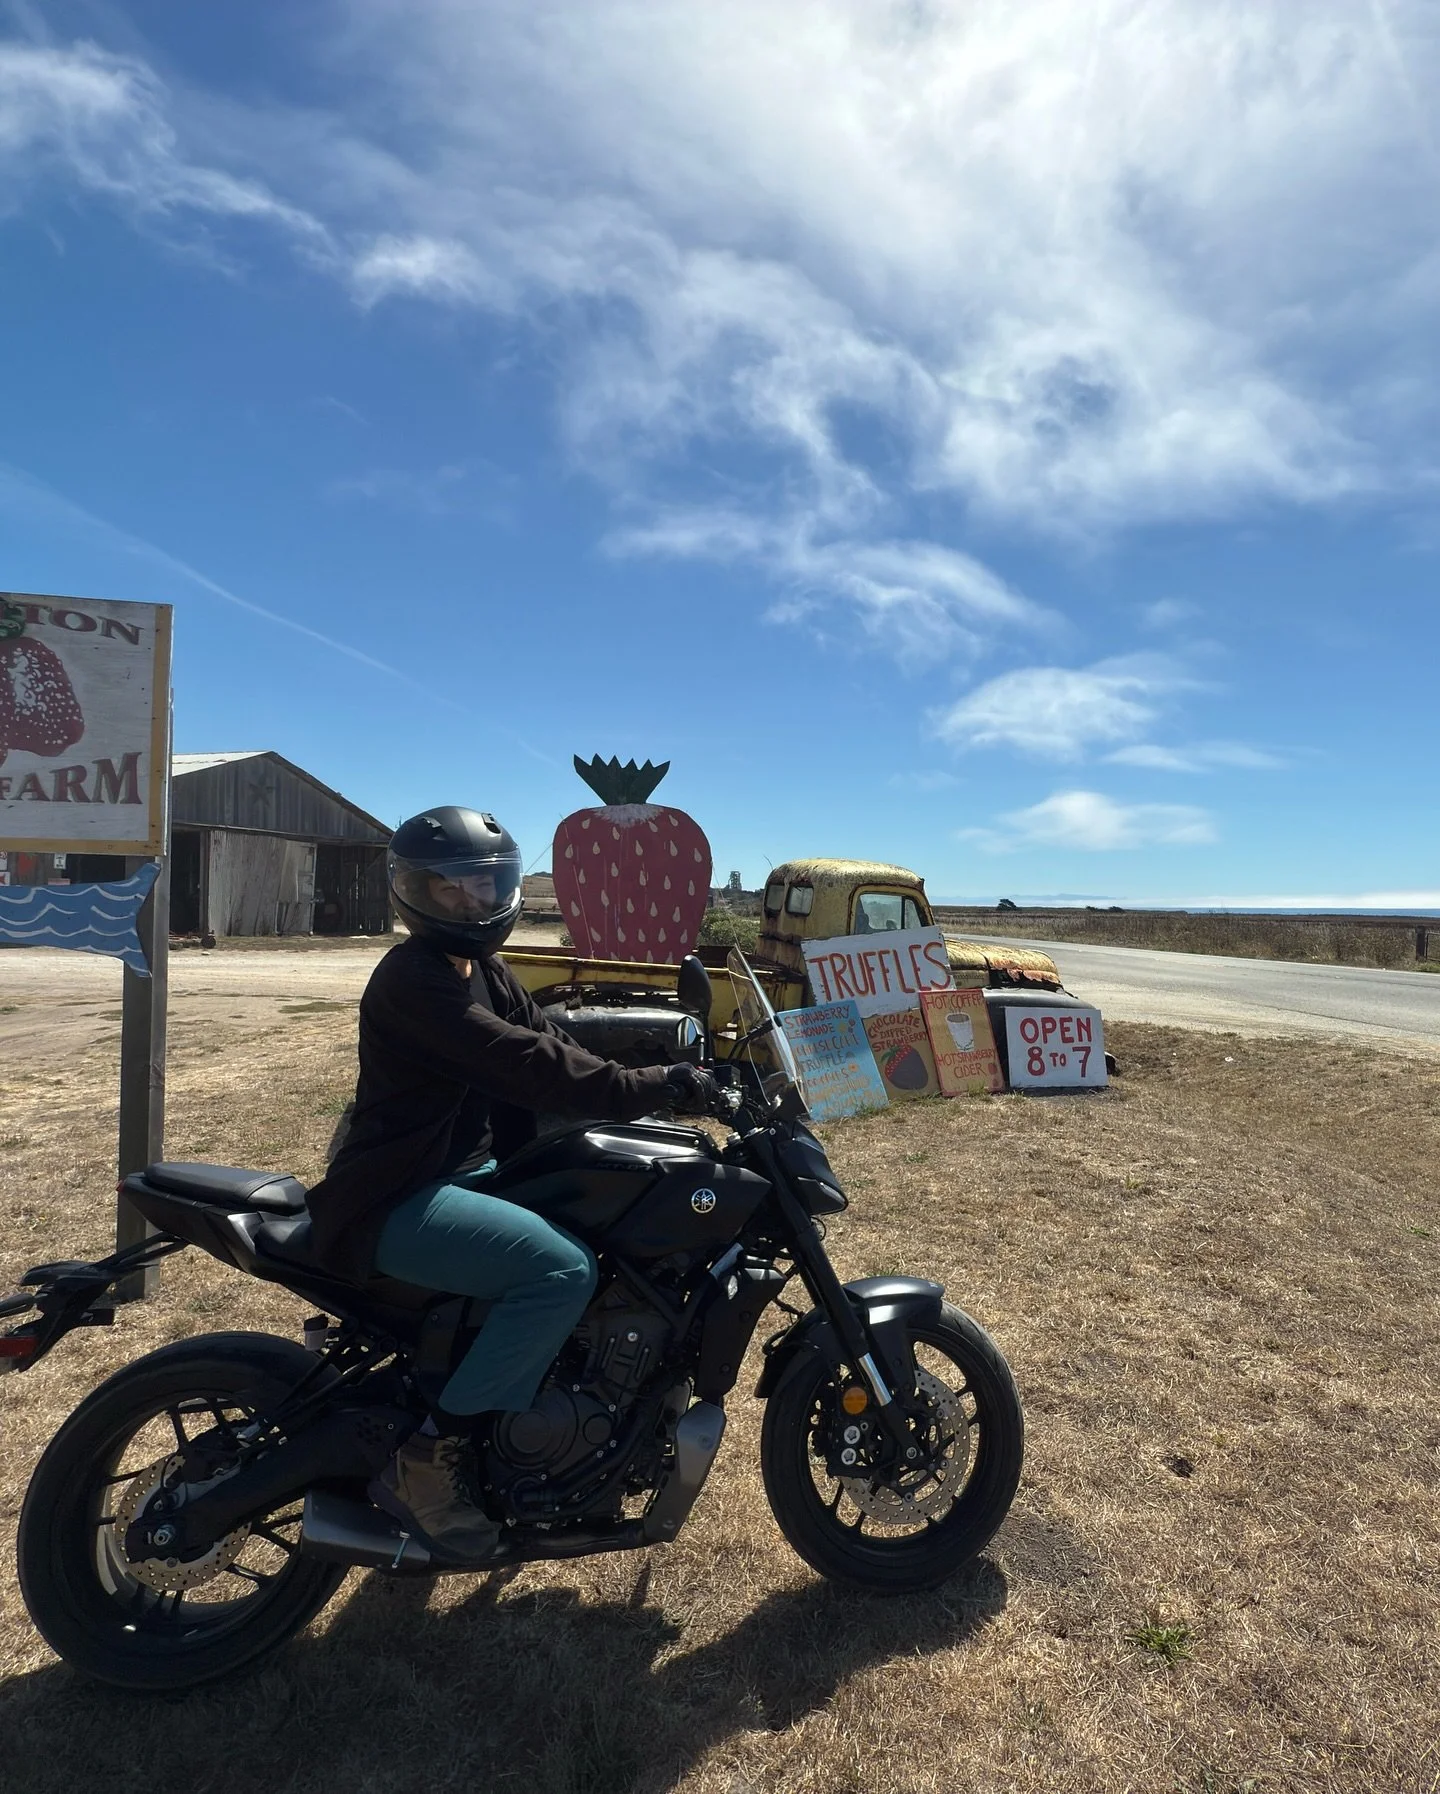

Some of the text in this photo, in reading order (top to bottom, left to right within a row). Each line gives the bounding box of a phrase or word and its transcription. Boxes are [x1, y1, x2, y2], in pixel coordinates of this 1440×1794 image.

[14, 601, 144, 645] TON
[0, 752, 143, 804] FARM
[808, 942, 951, 1002] TRUFFLES
[926, 993, 983, 1009] HOT COFFEE
[784, 1005, 850, 1029] STRAWBERRY
[868, 1013, 920, 1038] CHOCOLATE
[785, 1023, 835, 1040] LEMONADE
[871, 1031, 928, 1053] STRAWBERRY
[880, 1026, 913, 1039] DIPPED
[1020, 1016, 1092, 1044] OPEN
[936, 1048, 996, 1066] HOT STRAWBERRY
[1027, 1046, 1092, 1078] 8 TO 7
[954, 1063, 987, 1078] CIDER
